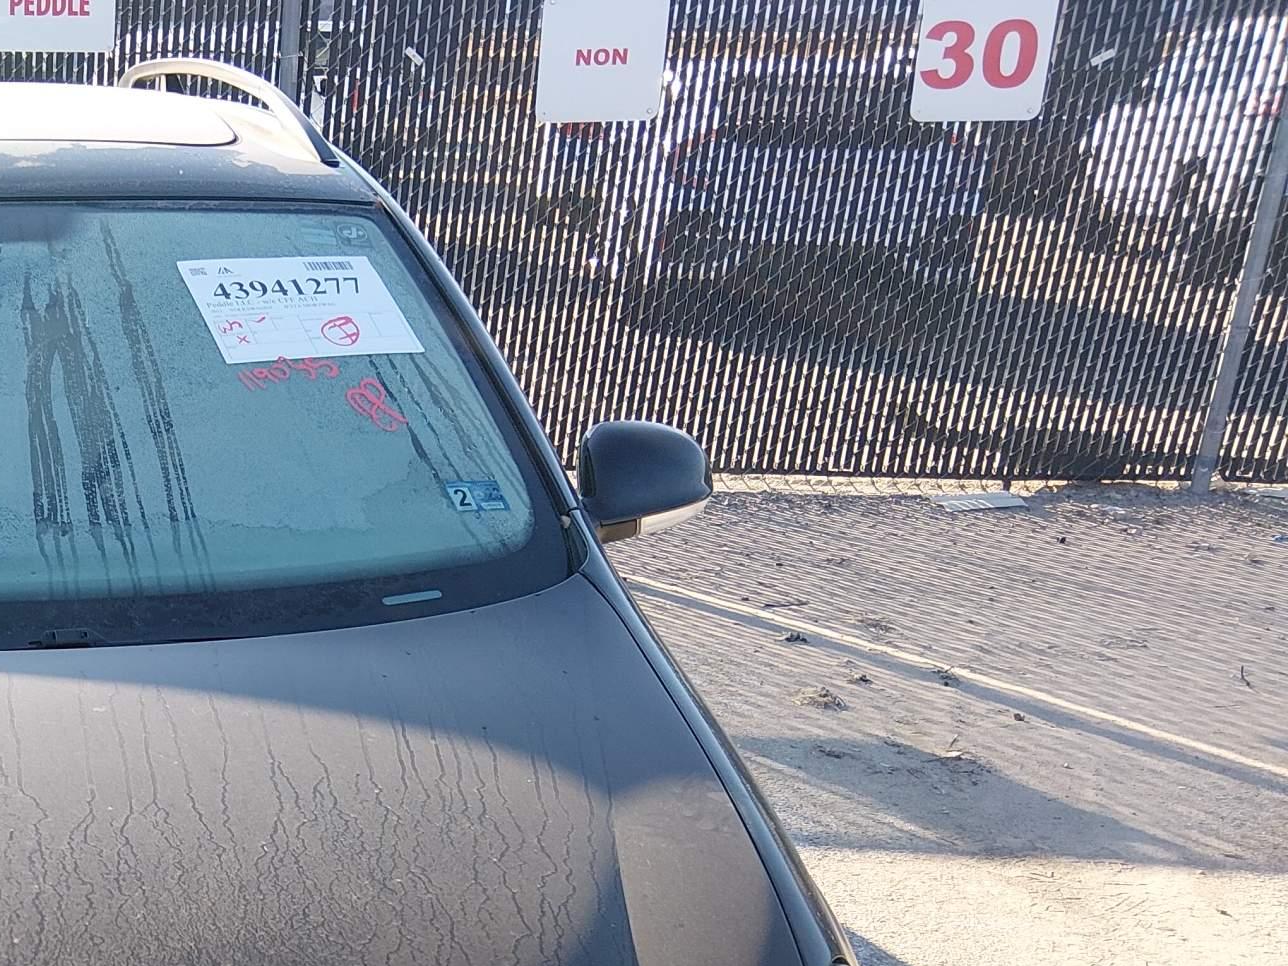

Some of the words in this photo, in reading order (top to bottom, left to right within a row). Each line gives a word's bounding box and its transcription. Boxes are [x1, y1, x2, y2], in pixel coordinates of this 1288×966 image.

[9, 0, 90, 16] PEDDLE
[575, 47, 629, 66] NON
[920, 18, 1039, 90] 30
[213, 276, 360, 300] 43941277
[453, 489, 473, 507] 2
